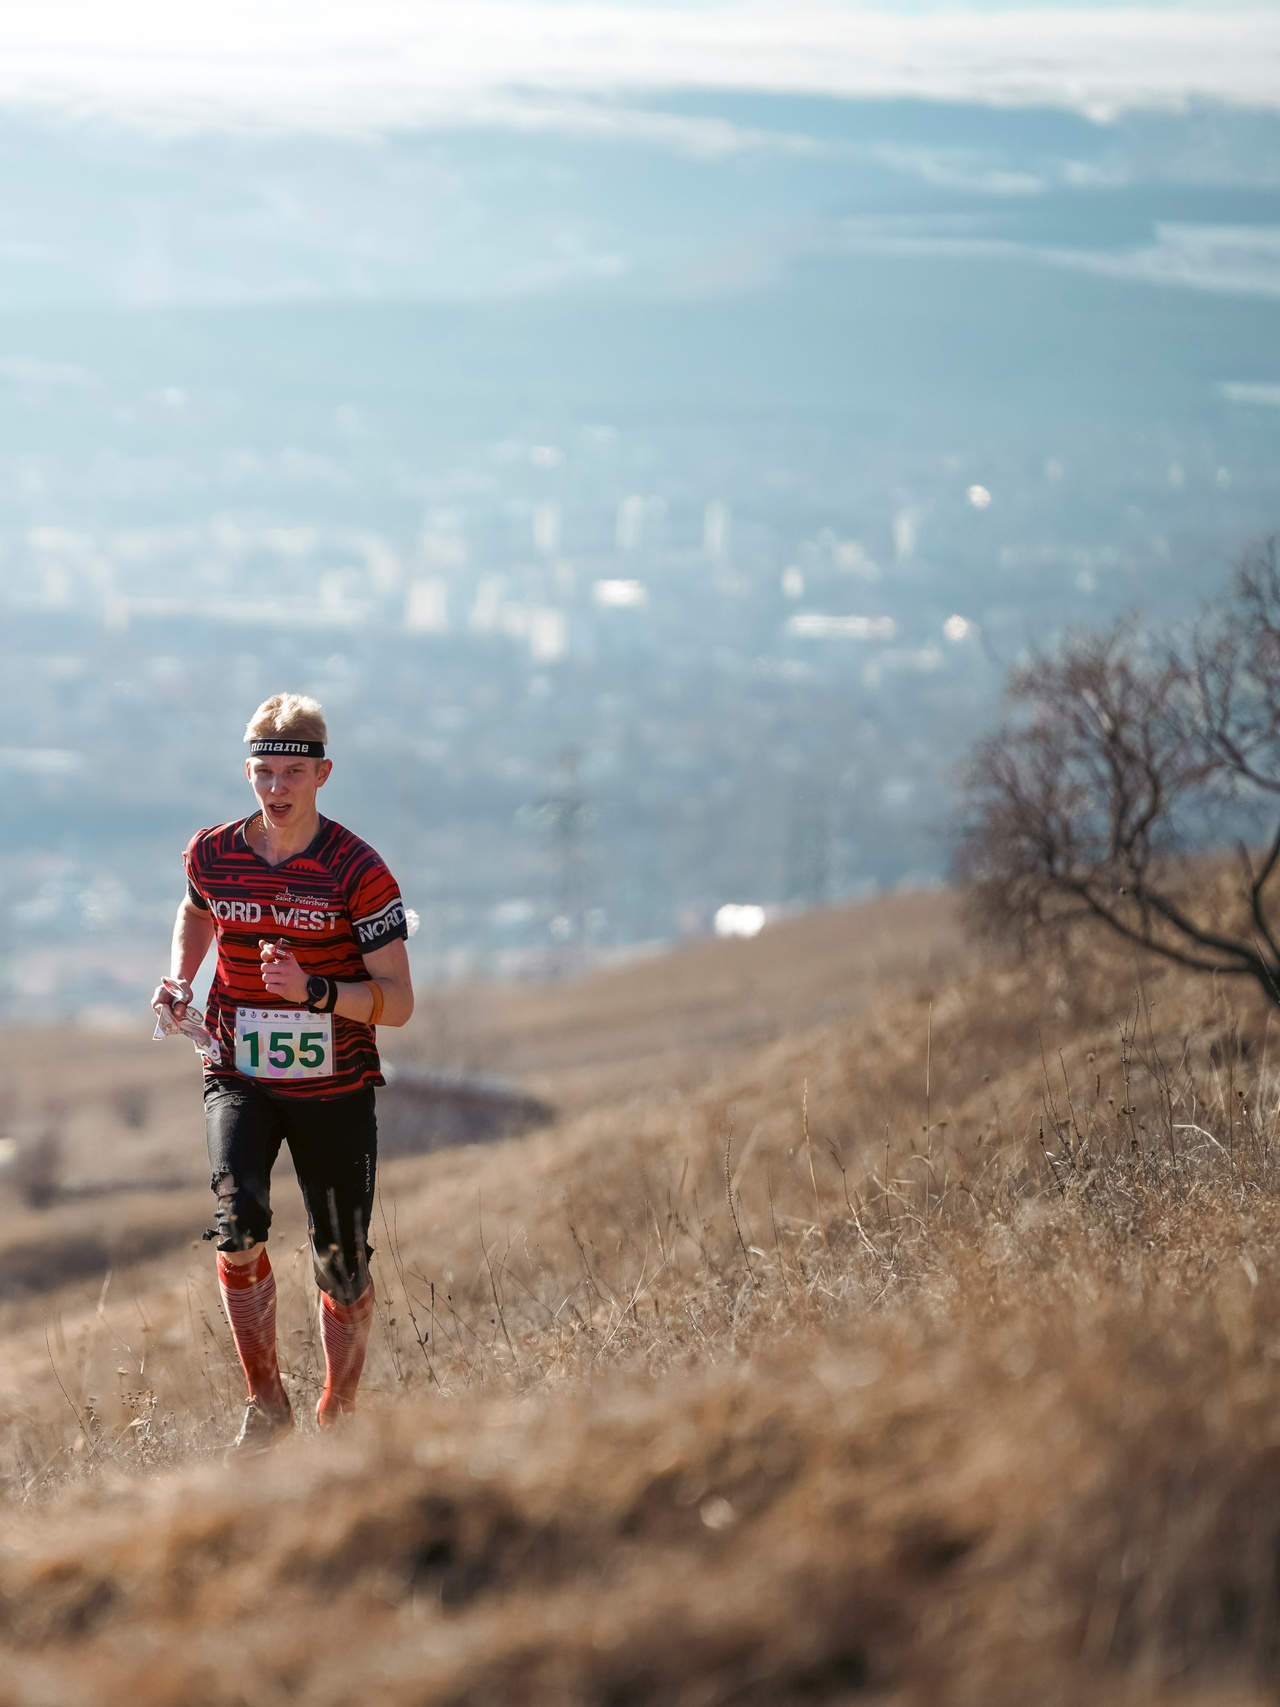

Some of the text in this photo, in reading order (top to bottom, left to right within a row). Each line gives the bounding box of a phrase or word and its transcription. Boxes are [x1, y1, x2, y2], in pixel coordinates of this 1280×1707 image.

[251, 742, 309, 753] noname
[207, 898, 341, 931] NORD WEST
[275, 895, 329, 909] Saint-Petersburg
[358, 906, 405, 943] NORD
[243, 1031, 325, 1069] 155
